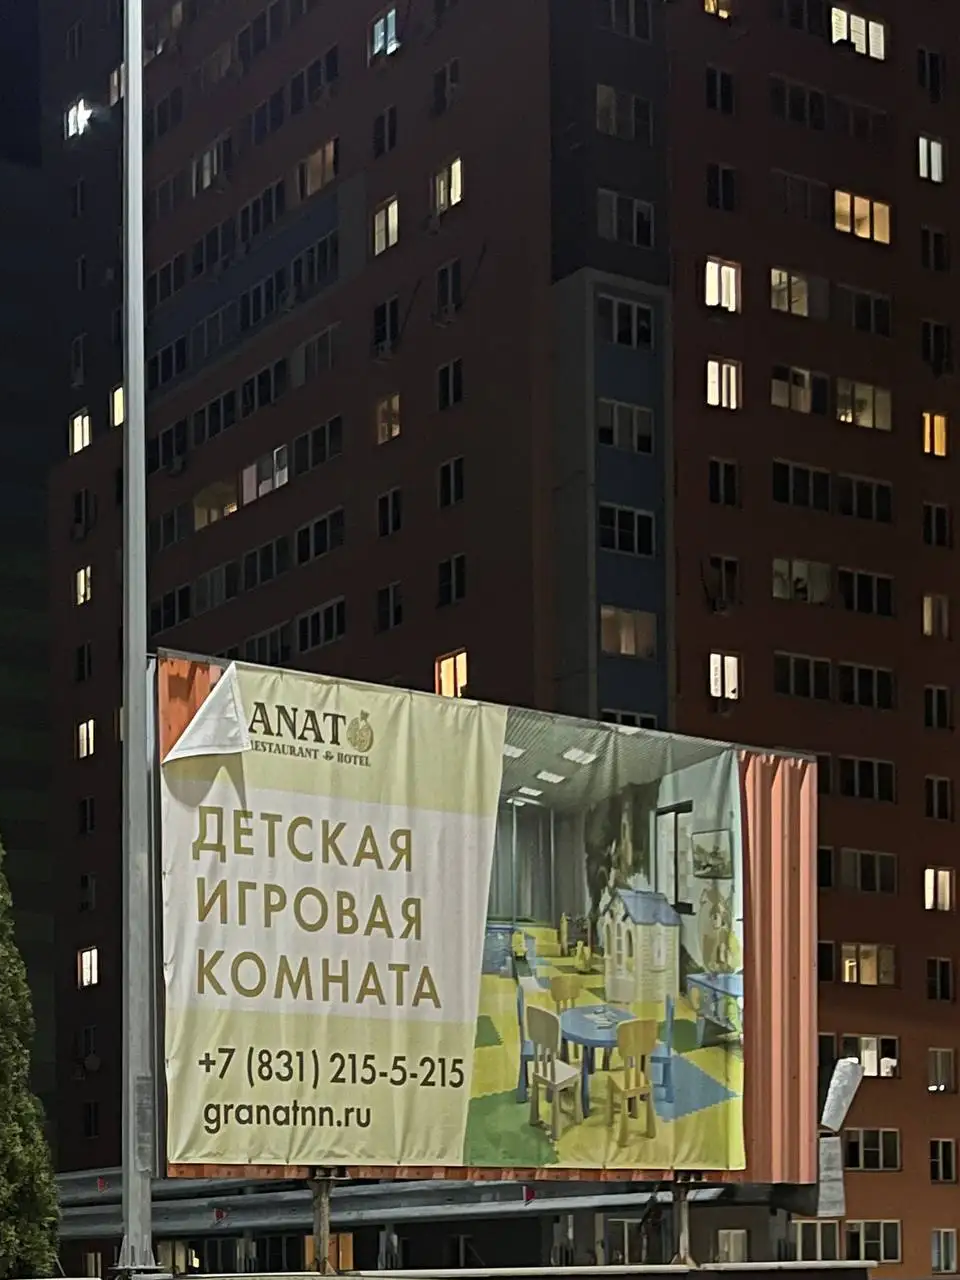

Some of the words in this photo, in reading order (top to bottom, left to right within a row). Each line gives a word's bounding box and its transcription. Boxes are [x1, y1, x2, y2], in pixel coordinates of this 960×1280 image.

[322, 750, 334, 761] &
[337, 752, 371, 767] HOTEL
[192, 806, 413, 873] ДЕТСКАЯ
[197, 876, 422, 941] ИГРОВАЯ
[197, 949, 442, 1009] КОМНАТА
[198, 1048, 236, 1080] +7
[247, 1047, 320, 1089] (831)
[329, 1053, 465, 1088] 215-5-215
[203, 1100, 371, 1134] granatnn.ru
